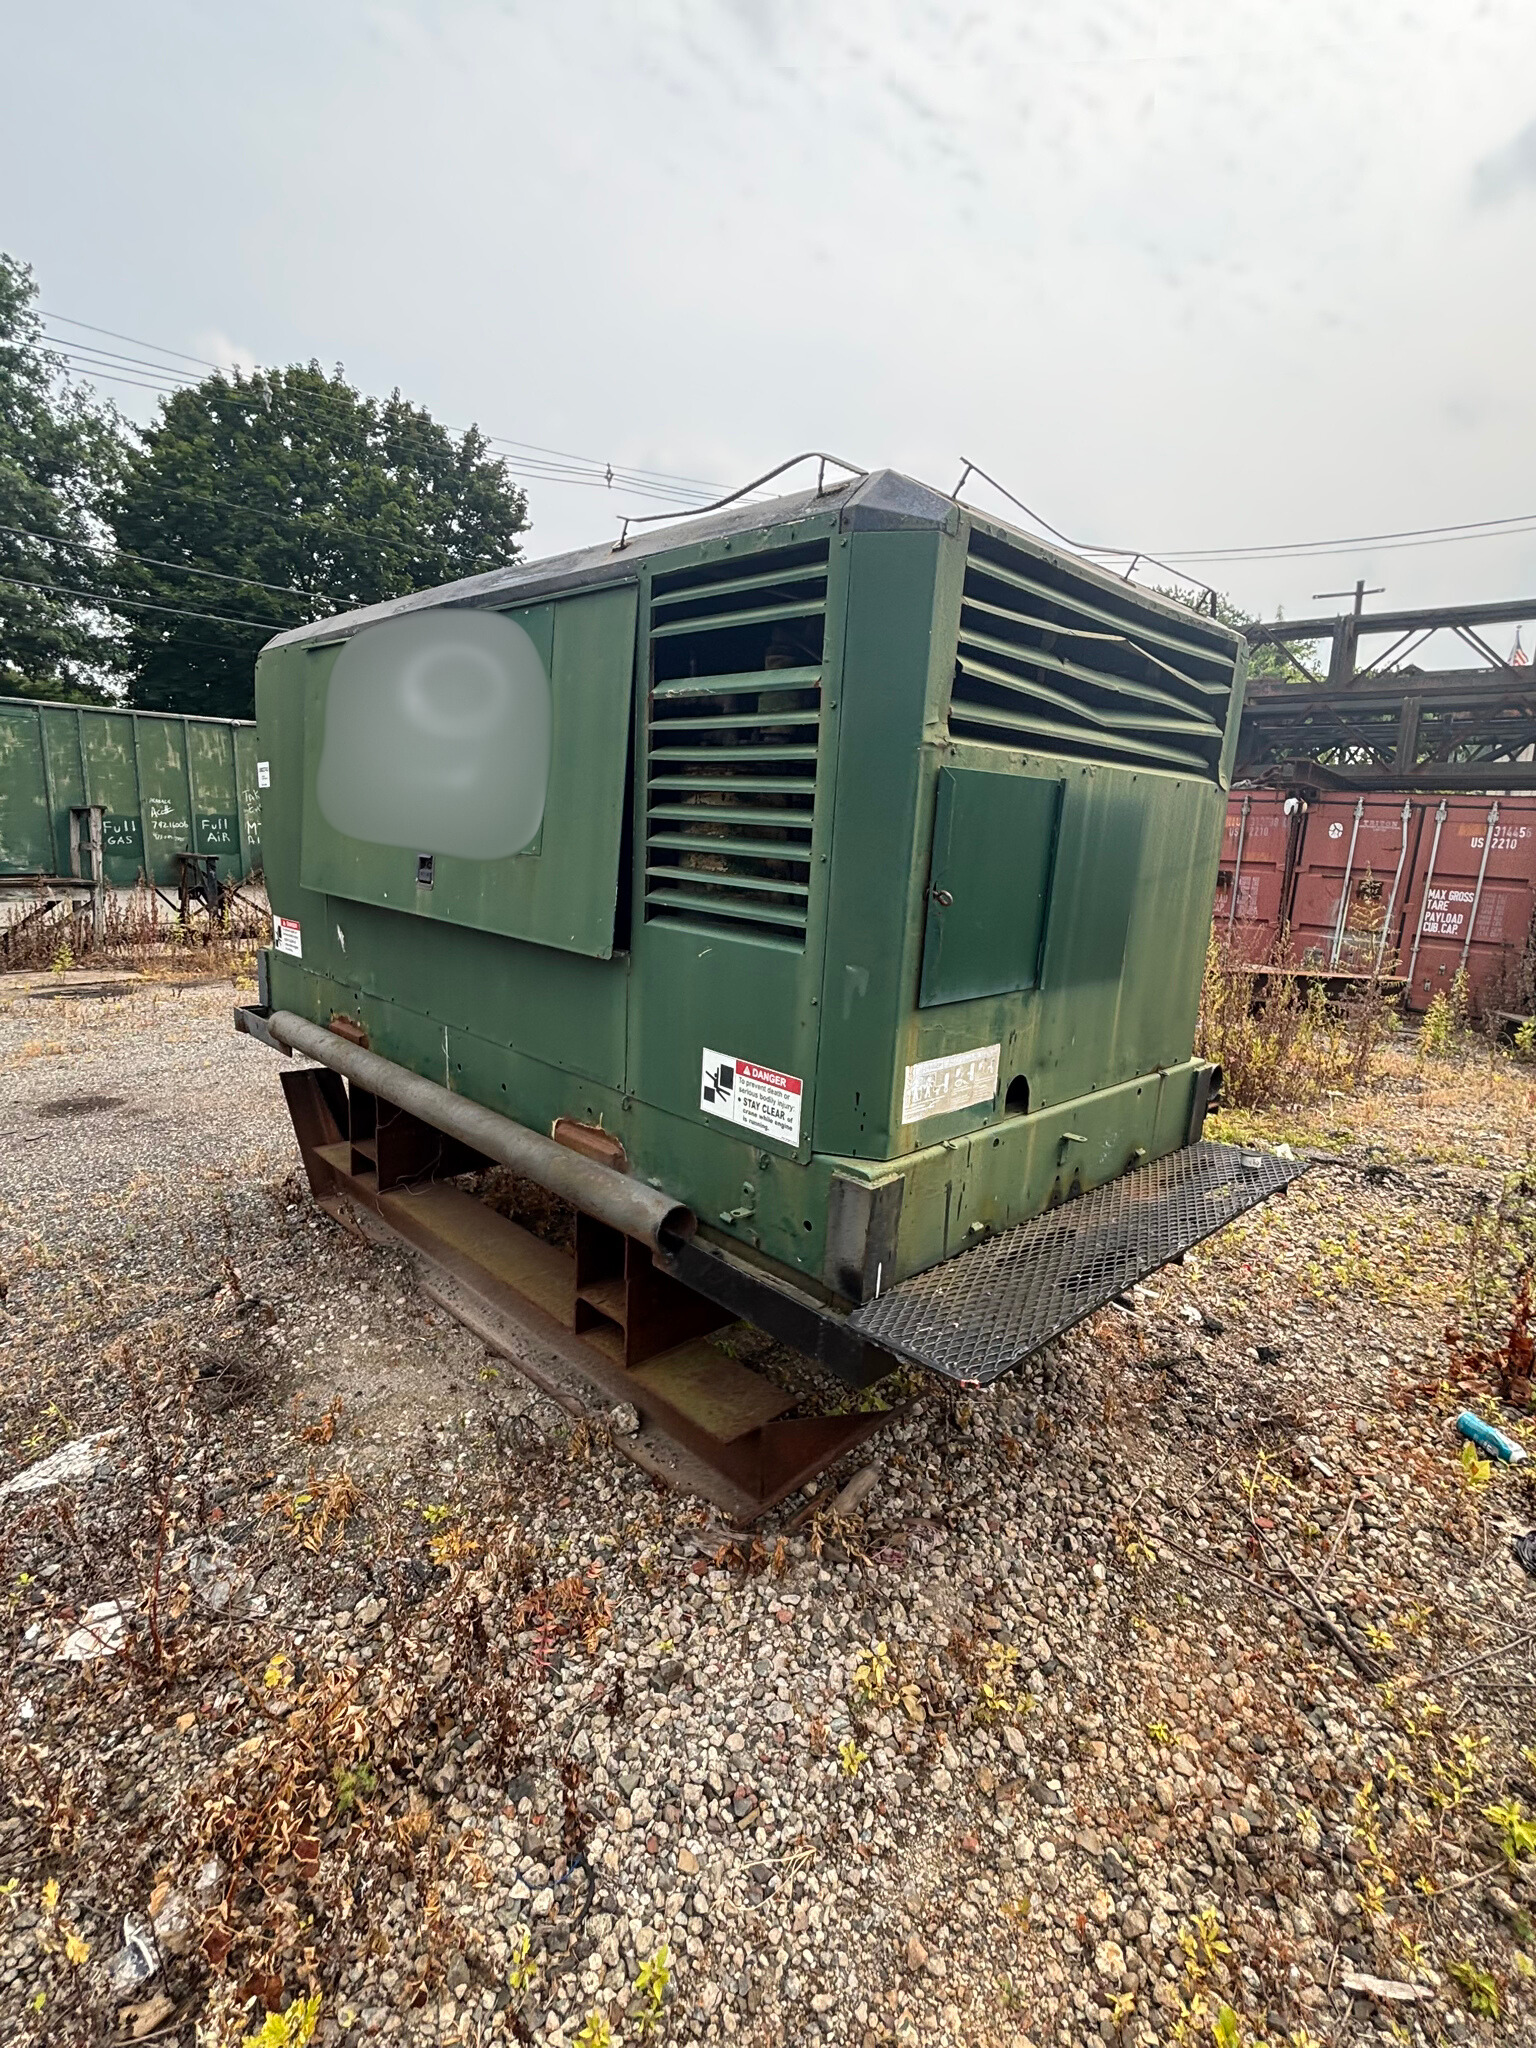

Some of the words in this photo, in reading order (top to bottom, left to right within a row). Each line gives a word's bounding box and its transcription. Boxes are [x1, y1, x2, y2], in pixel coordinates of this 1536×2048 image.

[103, 820, 137, 833] Full
[201, 818, 228, 830] Full
[1229, 827, 1239, 837] US
[1249, 827, 1269, 837] 2210
[107, 835, 133, 845] GAS
[1471, 837, 1484, 848] US
[1491, 838, 1518, 849] 2210
[1428, 889, 1447, 900] MAX
[1448, 890, 1474, 903] GROSS
[1427, 900, 1450, 911] TARE
[1425, 911, 1464, 924] PAYLOAD
[752, 1068, 787, 1088] DANGER
[739, 1087, 758, 1099] serious
[760, 1093, 777, 1106] bodily
[746, 1080, 767, 1093] prevent
[767, 1085, 782, 1098] death
[783, 1092, 791, 1100] or
[743, 1097, 761, 1110] STAY
[762, 1104, 786, 1121] CLEAR
[743, 1109, 758, 1118] crane
[759, 1113, 774, 1124] while
[774, 1120, 793, 1132] engine
[749, 1119, 770, 1132] running.
